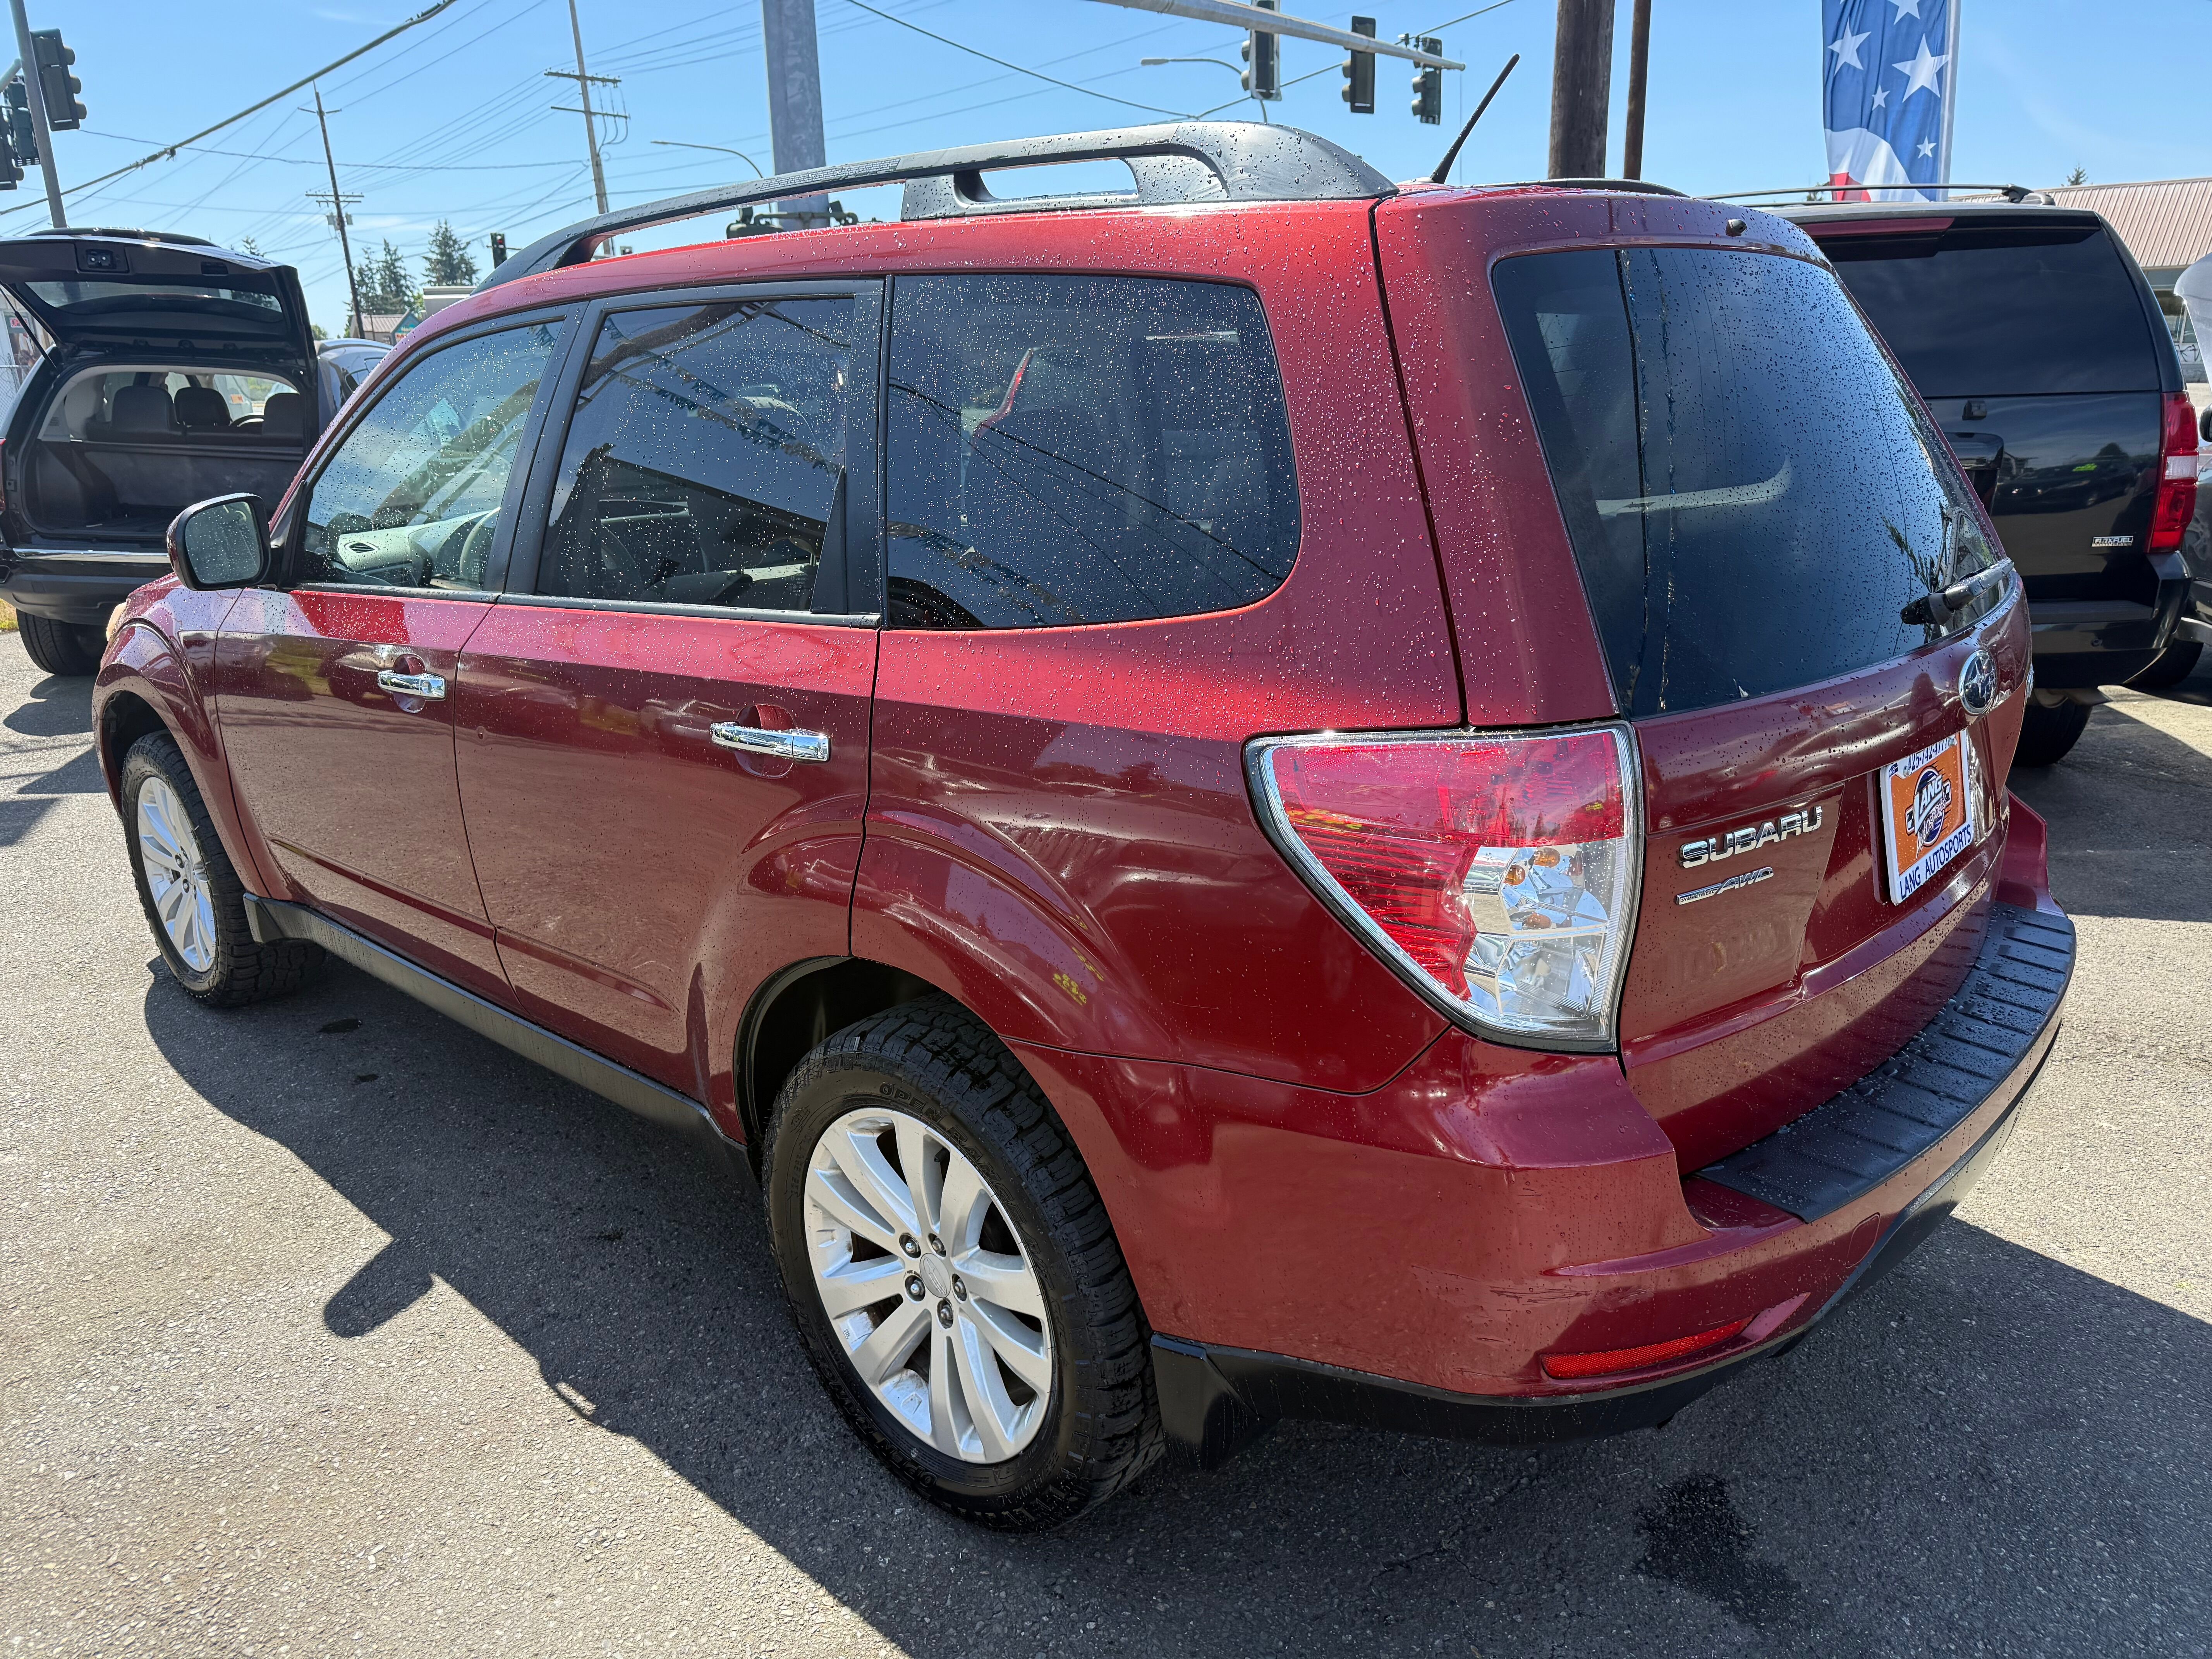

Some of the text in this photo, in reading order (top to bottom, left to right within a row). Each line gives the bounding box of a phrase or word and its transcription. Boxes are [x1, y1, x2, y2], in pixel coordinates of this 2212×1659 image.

[1914, 774, 1943, 836] LANG
[1680, 805, 1822, 868] SUBARU
[1899, 824, 1972, 900] LANG AUTOSPORTS
[1680, 866, 1774, 902] SYMMETRICAL AWD
[879, 1082, 946, 1123] OPEN
[947, 1125, 1026, 1224] RANGE
[872, 1436, 938, 1488] OPEN
